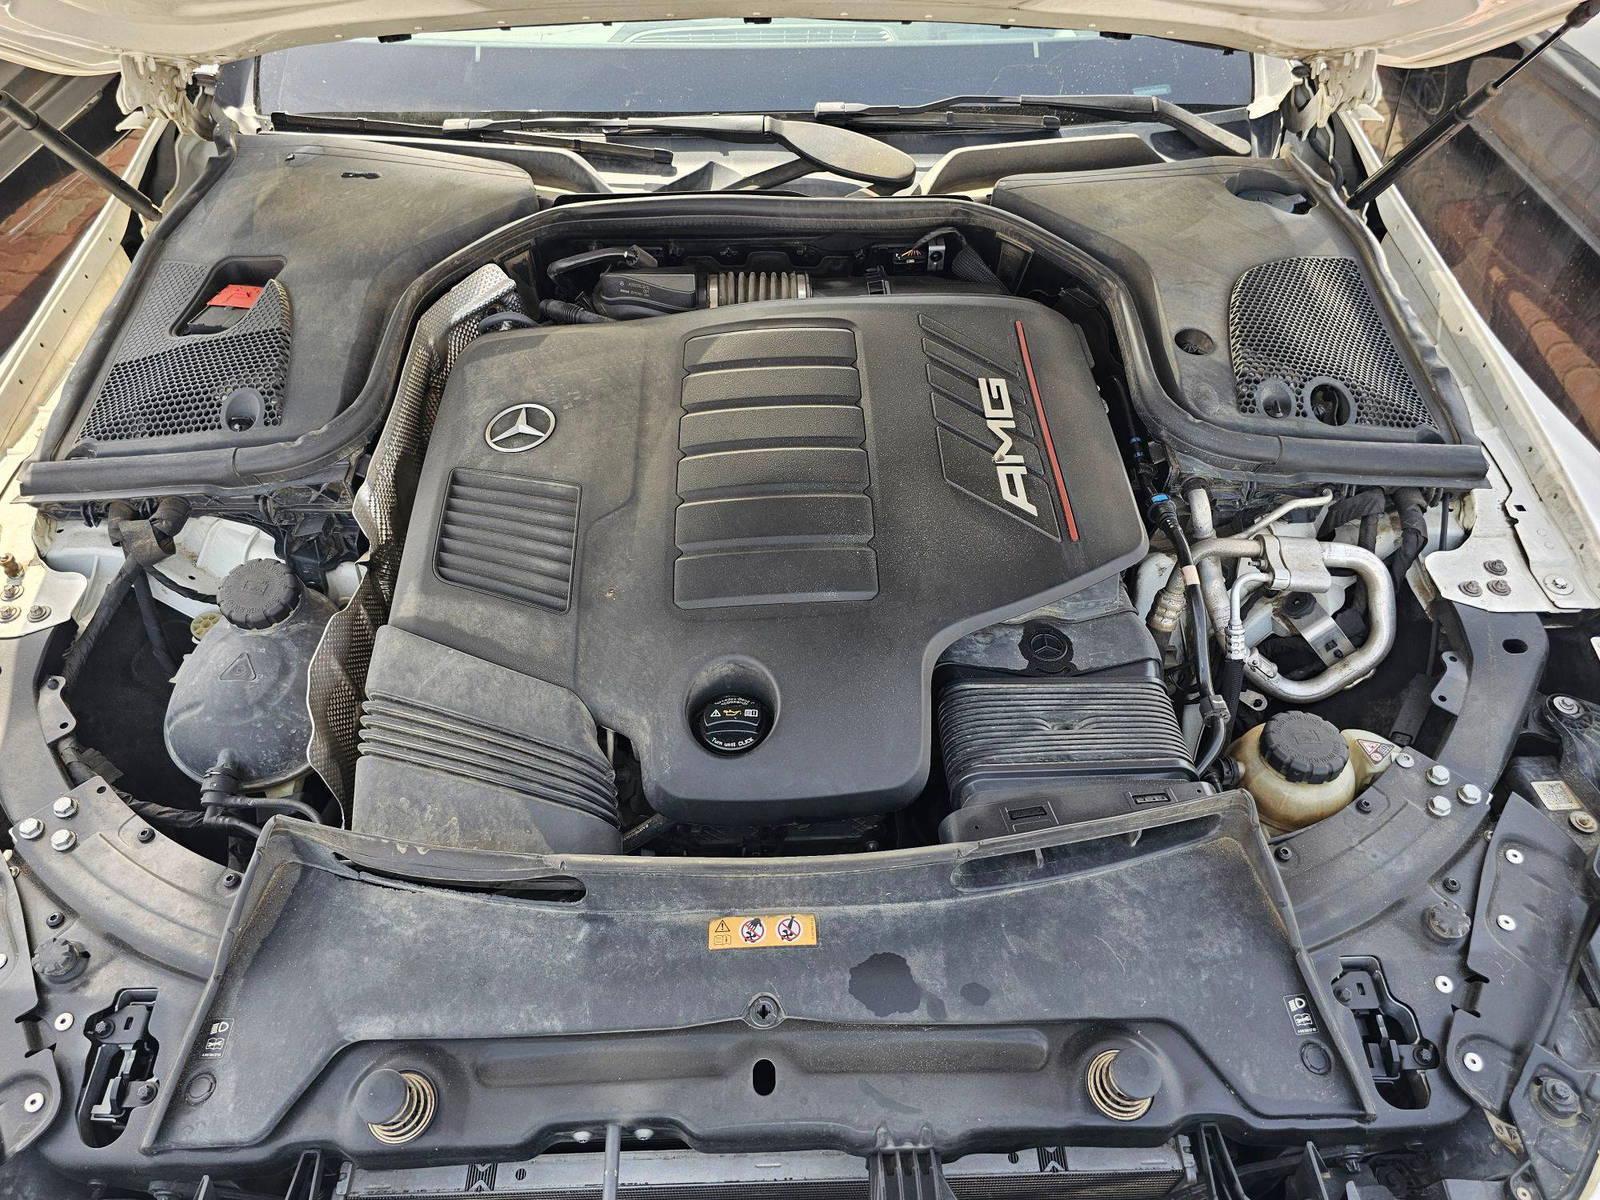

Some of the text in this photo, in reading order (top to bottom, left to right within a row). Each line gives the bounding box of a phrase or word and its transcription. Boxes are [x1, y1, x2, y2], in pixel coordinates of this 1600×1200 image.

[978, 377, 1038, 517] AMG
[711, 737, 723, 746] Turn
[738, 737, 754, 746] CLICK
